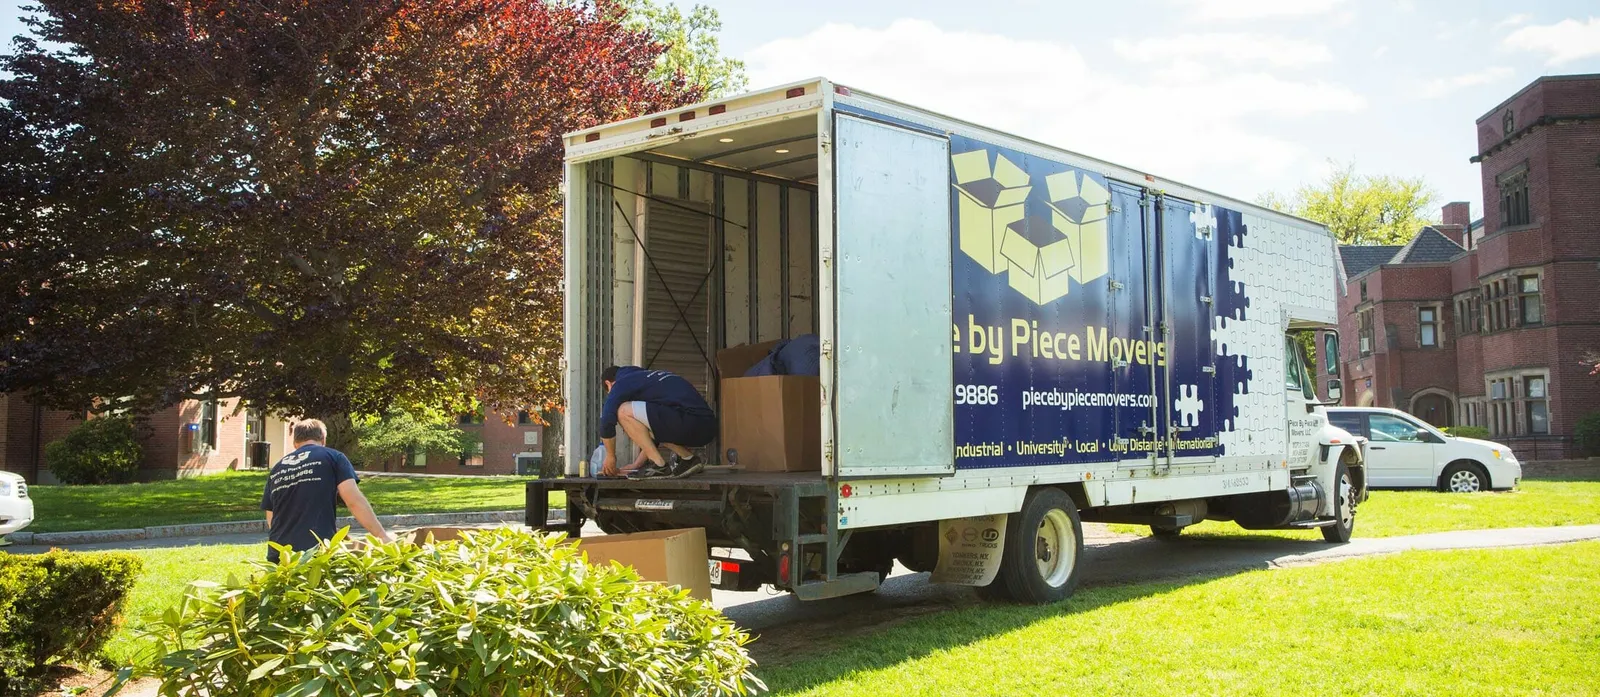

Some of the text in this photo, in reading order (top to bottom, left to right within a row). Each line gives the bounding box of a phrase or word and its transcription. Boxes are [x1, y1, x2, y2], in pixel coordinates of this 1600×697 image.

[968, 314, 1004, 365] by
[1011, 318, 1081, 361] Piece
[1086, 325, 1167, 367] Movers
[955, 384, 999, 405] 9886
[1022, 386, 1158, 411] piecebypiecemovers.com
[955, 441, 1004, 459] ndustrial
[1016, 440, 1065, 457] University
[1075, 439, 1099, 453] Local
